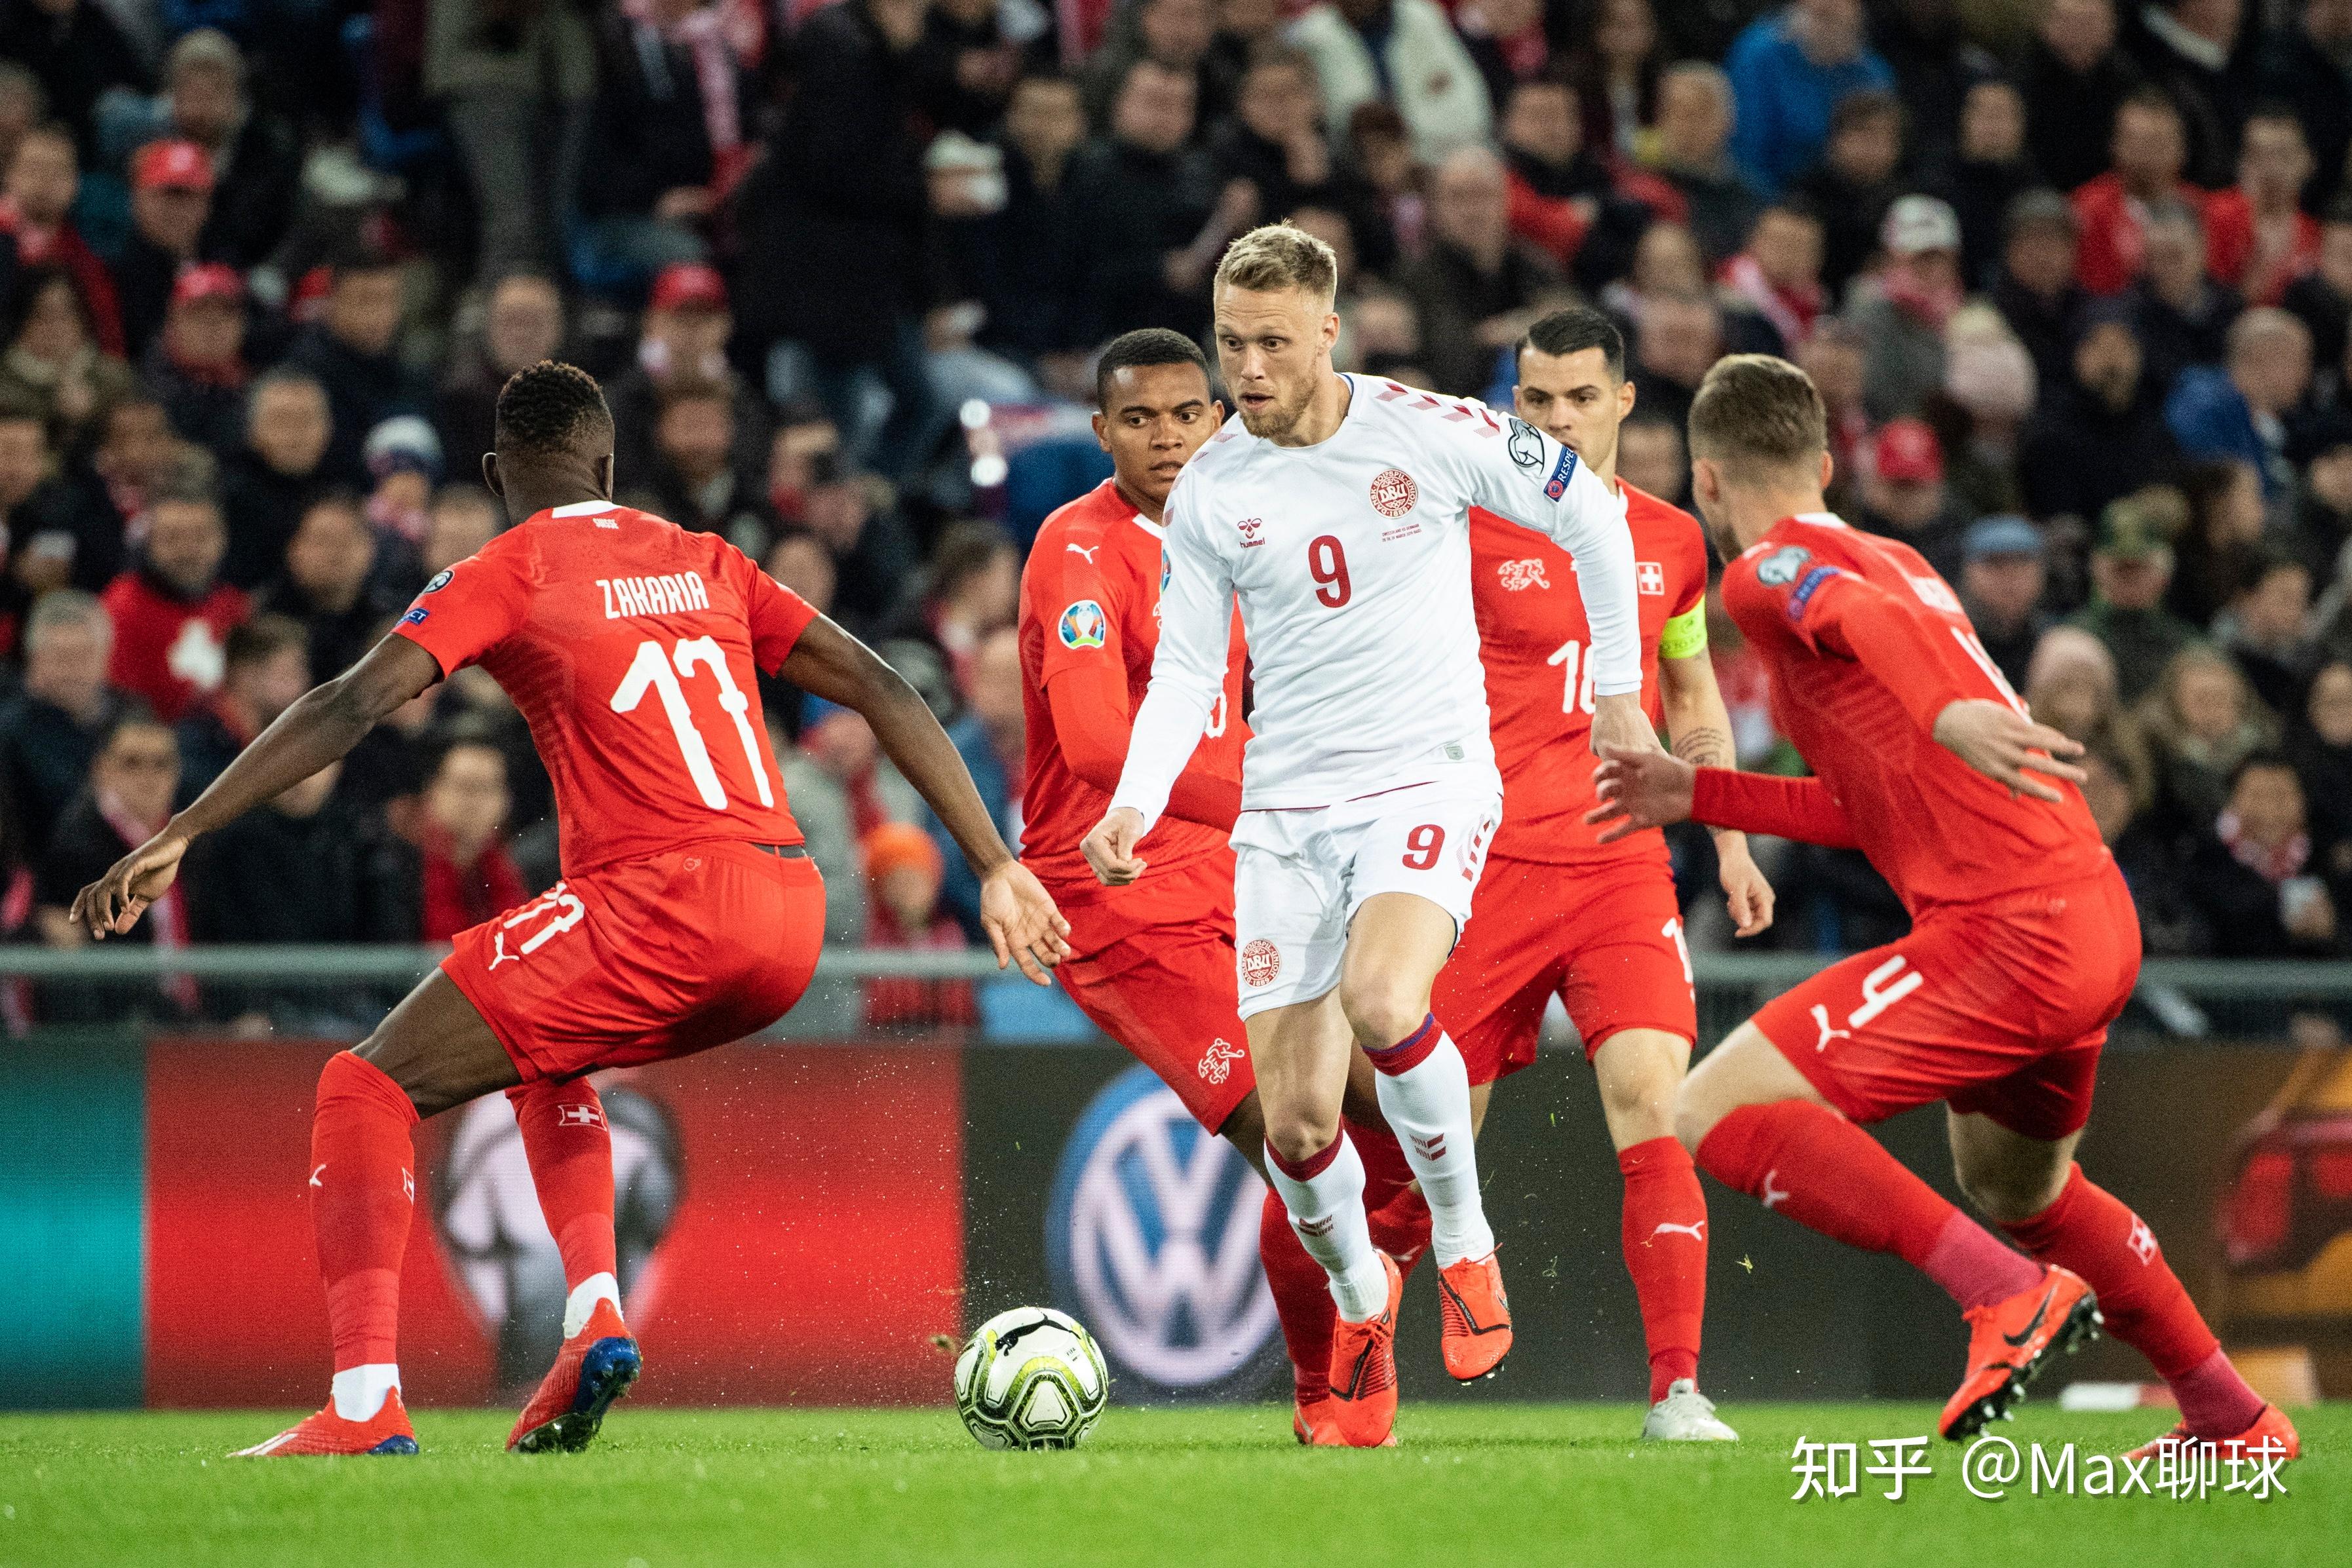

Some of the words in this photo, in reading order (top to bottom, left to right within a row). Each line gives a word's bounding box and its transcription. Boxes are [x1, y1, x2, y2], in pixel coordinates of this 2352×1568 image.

[1378, 483, 1408, 503] DBU
[1239, 537, 1265, 549] hummel
[595, 571, 710, 620] ZAKARIA
[1308, 535, 1351, 608] 9
[610, 635, 775, 811] 17
[1402, 824, 1446, 871] 9
[503, 882, 585, 955] 17
[1246, 953, 1271, 972] DBU
[1848, 955, 1923, 1029] 4
